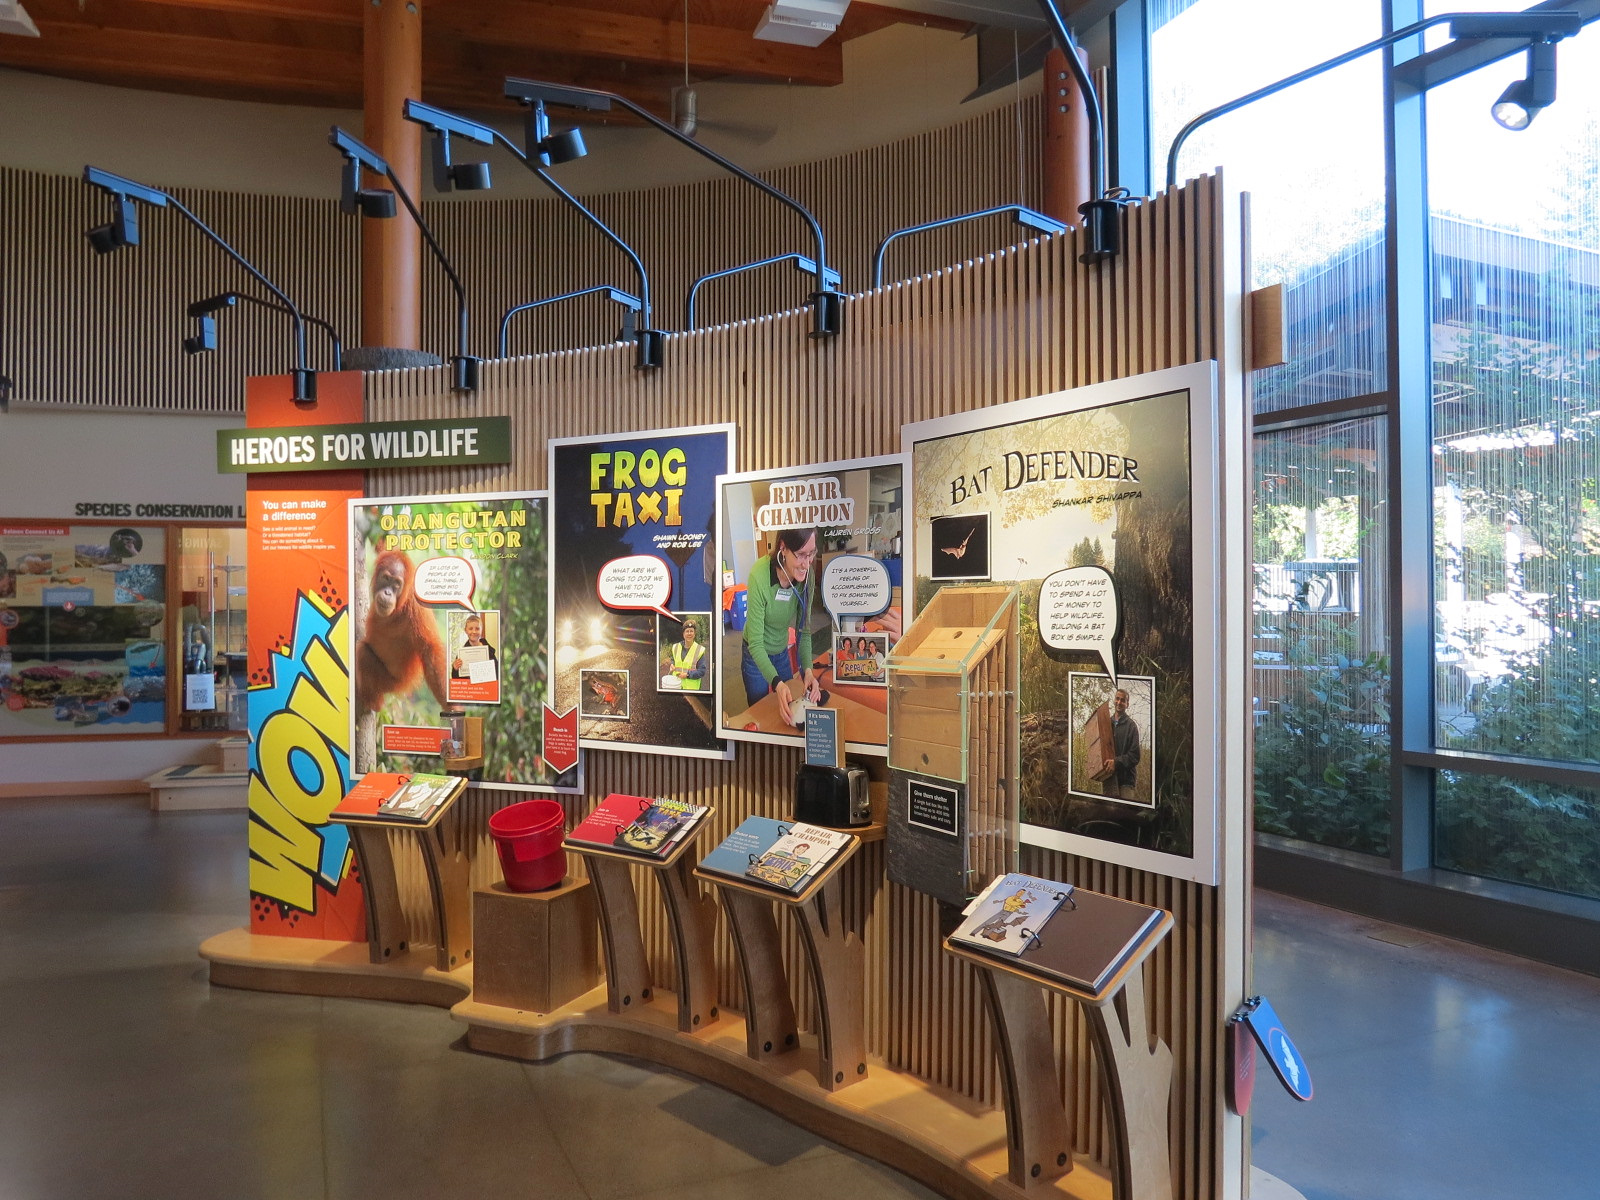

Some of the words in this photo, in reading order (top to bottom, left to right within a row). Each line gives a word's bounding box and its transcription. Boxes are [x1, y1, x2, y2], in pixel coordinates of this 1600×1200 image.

[231, 436, 315, 465] HEROES
[322, 433, 366, 462] FOR
[370, 428, 479, 460] WILDLIFE
[590, 448, 687, 490] FROG
[950, 466, 992, 506] BAT
[1003, 450, 1140, 492] DEFENDER
[773, 482, 838, 505] REPAIR
[1052, 496, 1094, 508] SHANKAR
[1096, 491, 1142, 503] SHIVAPPA
[75, 503, 131, 516] SPECIES
[136, 504, 233, 518] CONSERVATION
[262, 500, 278, 510] You
[282, 501, 298, 509] can
[301, 500, 327, 508] make
[590, 488, 683, 528] TAXI
[263, 513, 269, 521] a
[272, 512, 316, 520] difference
[380, 510, 526, 531] ORANGUTAN
[760, 502, 851, 527] CHAMPION
[652, 534, 678, 542] SHAWN
[854, 526, 882, 535] GROSS
[386, 531, 522, 551] PROTECTOR
[1050, 579, 1062, 587] YOU
[1064, 579, 1085, 587] DON'T
[1088, 578, 1107, 586] HAVE
[249, 608, 349, 913] WOW
[794, 832, 831, 846] CHAMPION
[804, 828, 832, 838] REPAIR
[1022, 880, 1059, 894] DEFENDER
